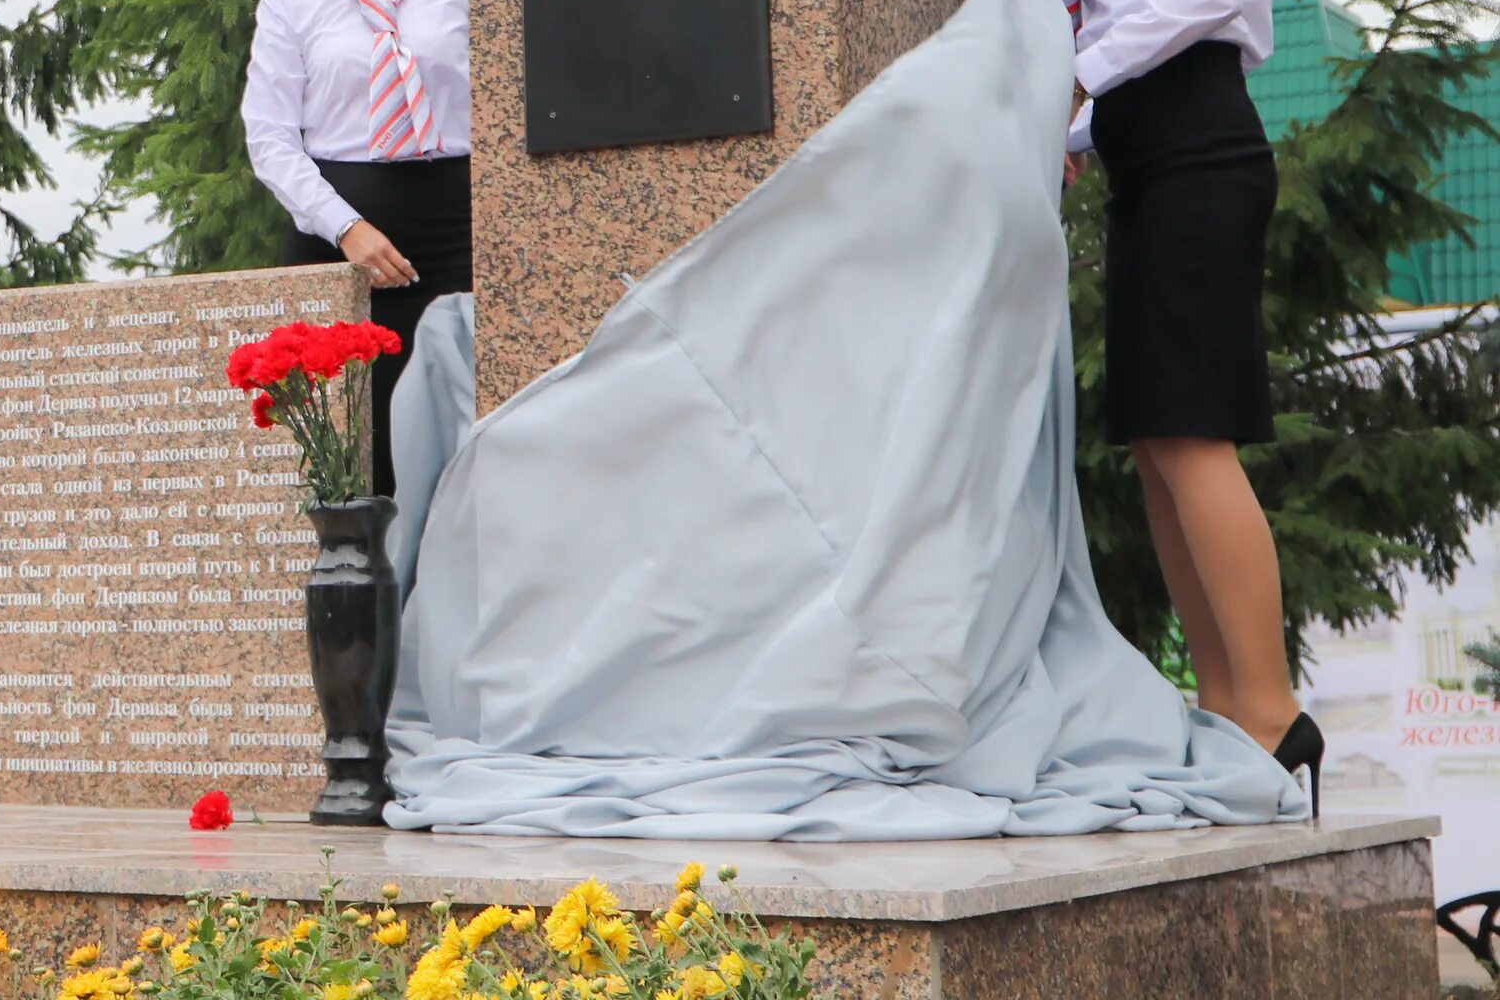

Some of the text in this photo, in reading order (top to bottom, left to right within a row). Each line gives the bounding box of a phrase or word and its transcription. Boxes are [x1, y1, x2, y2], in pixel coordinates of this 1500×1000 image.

[84, 315, 94, 329] и
[109, 310, 180, 329] меценат,
[196, 298, 284, 322] известный
[301, 299, 331, 314] как
[62, 339, 143, 357] железных
[152, 335, 199, 355] дорог
[209, 334, 218, 348] в
[228, 329, 269, 346] Росс
[49, 366, 119, 387] статский
[125, 365, 203, 383] советник.
[2, 396, 34, 418] фон
[38, 395, 96, 416] Дервиз
[100, 392, 167, 412] получил
[174, 387, 192, 405] 12
[196, 386, 244, 406] марта
[53, 413, 237, 438] Рязанско-Козловской
[22, 448, 86, 471] которой
[93, 446, 135, 465] было
[142, 446, 228, 463] закончено
[237, 441, 246, 459] 4
[253, 443, 304, 458] сентя
[1, 480, 43, 496] стала
[55, 474, 102, 496] одной
[113, 477, 131, 492] из
[142, 475, 203, 494] первых
[216, 474, 224, 488] в
[236, 470, 300, 487] России
[4, 508, 56, 528] грузов
[65, 508, 74, 522] и
[84, 507, 111, 521] это
[120, 505, 158, 523] дало
[169, 500, 187, 519] ей
[197, 504, 207, 518] с
[217, 501, 284, 521] первого
[79, 535, 132, 552] доход.
[147, 530, 159, 548] В
[173, 532, 220, 547] связи
[233, 531, 242, 545] с
[19, 560, 50, 579] был
[58, 562, 132, 582] достроен
[140, 557, 196, 580] второй
[205, 560, 242, 579] путь
[250, 559, 260, 573] к
[268, 555, 276, 573] 1
[285, 558, 316, 572] ию
[52, 588, 84, 610] фон
[95, 587, 178, 609] Дервизом
[189, 584, 231, 603] была
[244, 587, 306, 606] постро
[62, 619, 117, 637] дорога
[133, 618, 223, 632] полностью
[229, 617, 307, 632] закончен
[92, 668, 231, 689] действительным
[253, 673, 314, 687] статск
[63, 697, 96, 719] фон
[108, 697, 178, 720] Дервиза
[190, 697, 232, 716] была
[244, 702, 311, 721] первым
[14, 725, 79, 747] твердой
[100, 729, 111, 743] и
[131, 727, 208, 749] широкой
[230, 731, 325, 746] постановк
[1399, 726, 1500, 747] желез
[7, 756, 103, 774] инициативы
[107, 758, 115, 772] в
[121, 759, 282, 779] железнодорожном
